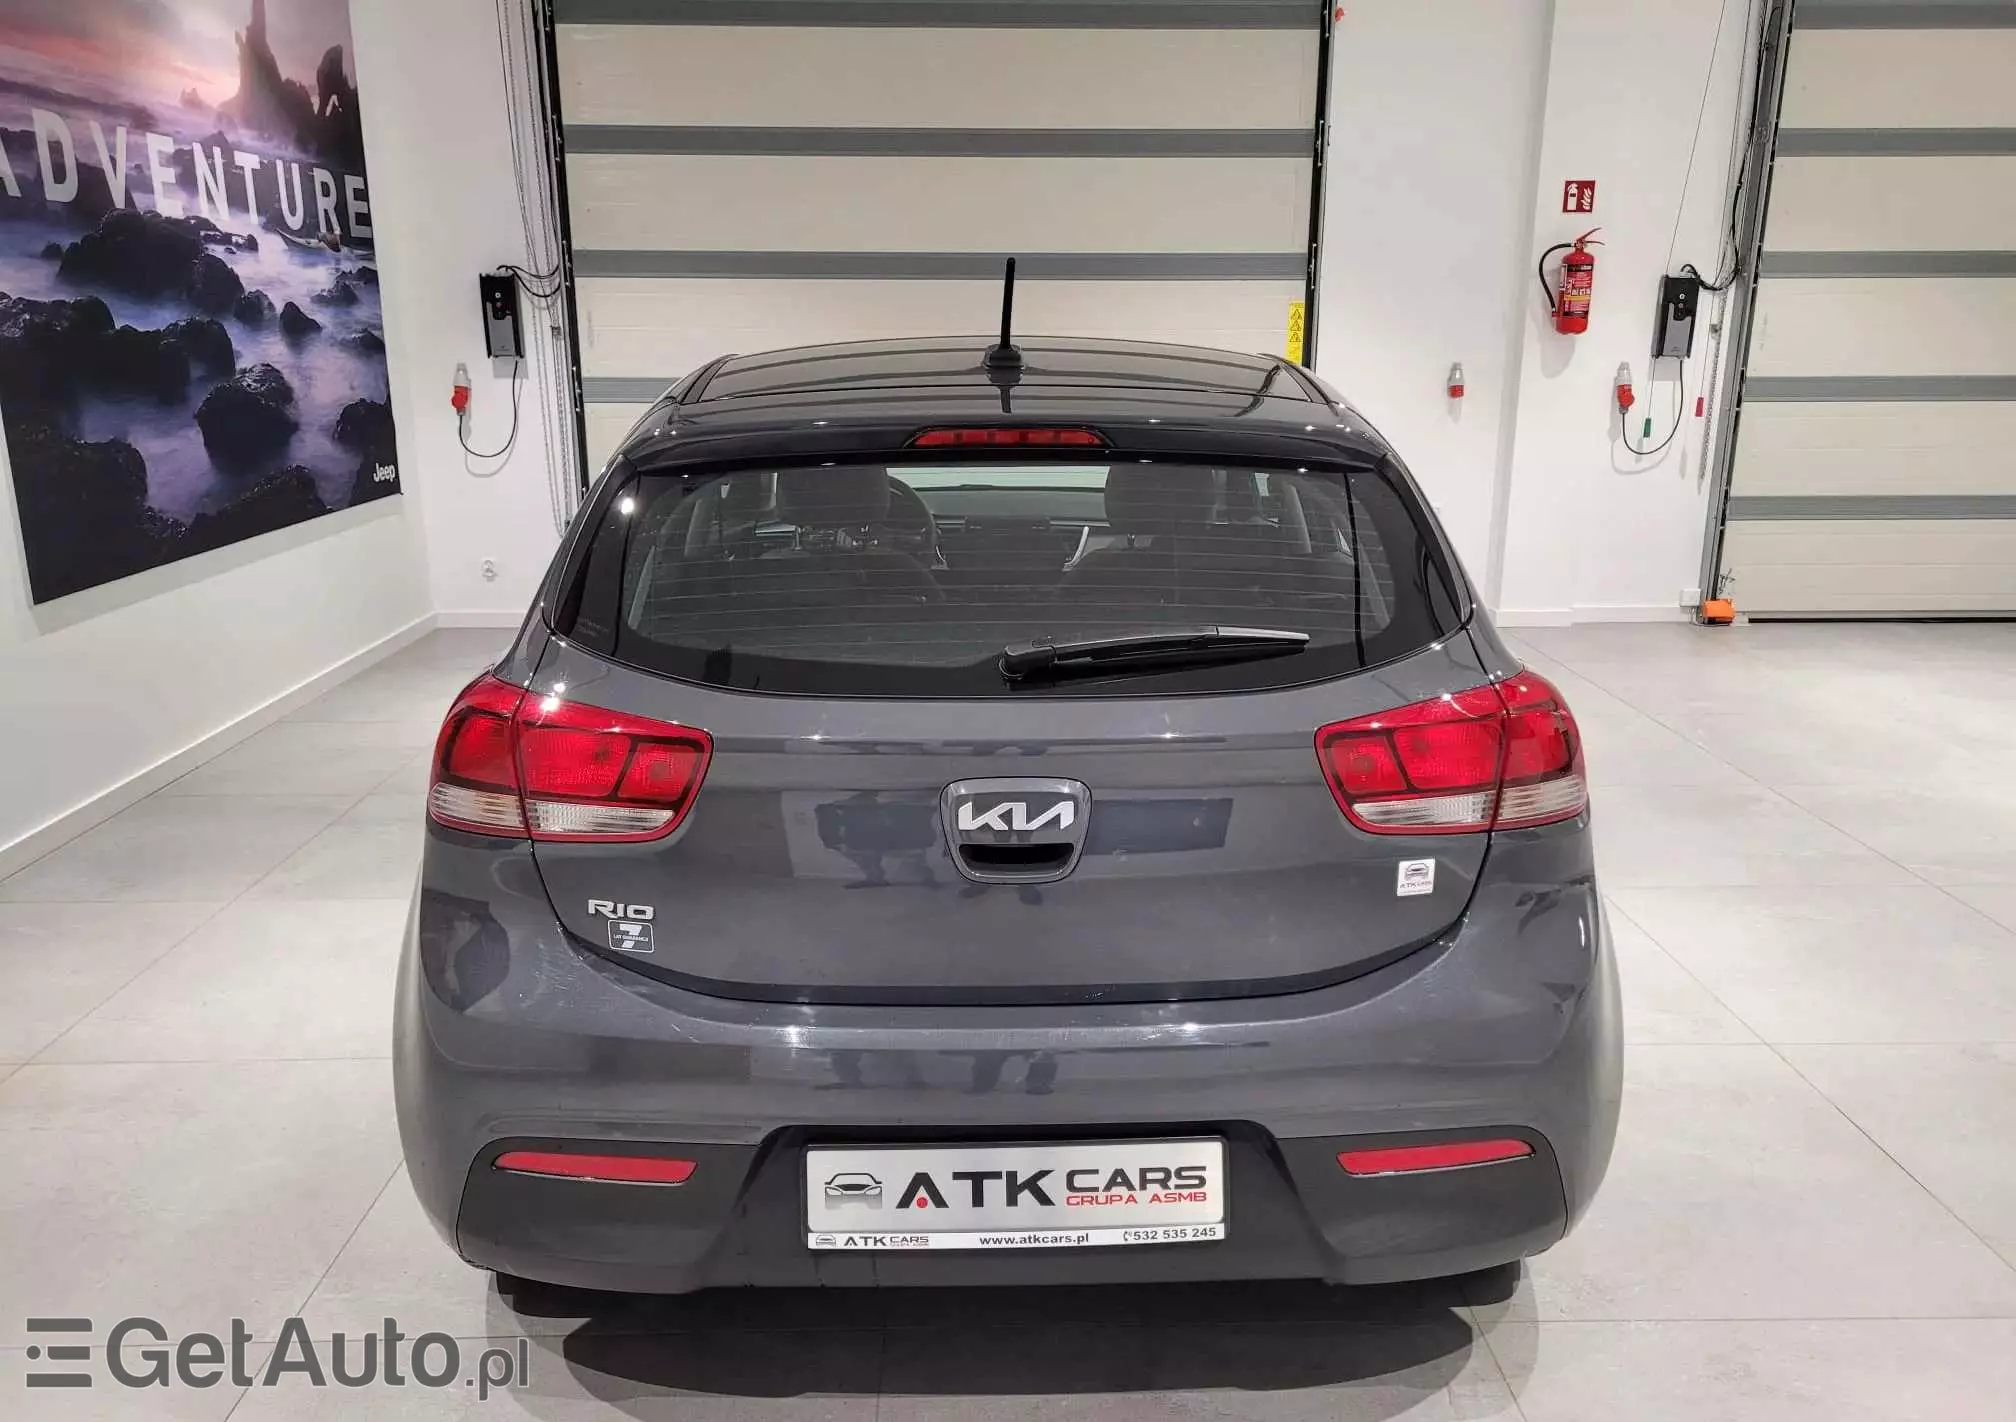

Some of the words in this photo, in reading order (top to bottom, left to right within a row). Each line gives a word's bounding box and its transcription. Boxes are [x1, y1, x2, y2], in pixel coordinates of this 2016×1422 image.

[373, 462, 395, 482] Jeep
[958, 801, 1075, 830] KIA
[588, 900, 654, 920] RIO
[895, 1169, 1056, 1209] ATK
[1066, 1166, 1207, 1192] CARS
[1066, 1193, 1138, 1206] GRUPA
[1149, 1192, 1207, 1204] ASMB
[843, 1235, 886, 1246] ATK
[890, 1235, 929, 1243] CARS
[979, 1232, 1089, 1245] www.atkcars.pl
[1133, 1228, 1158, 1241] 532
[1163, 1228, 1187, 1240] 535
[1192, 1227, 1216, 1238] 245
